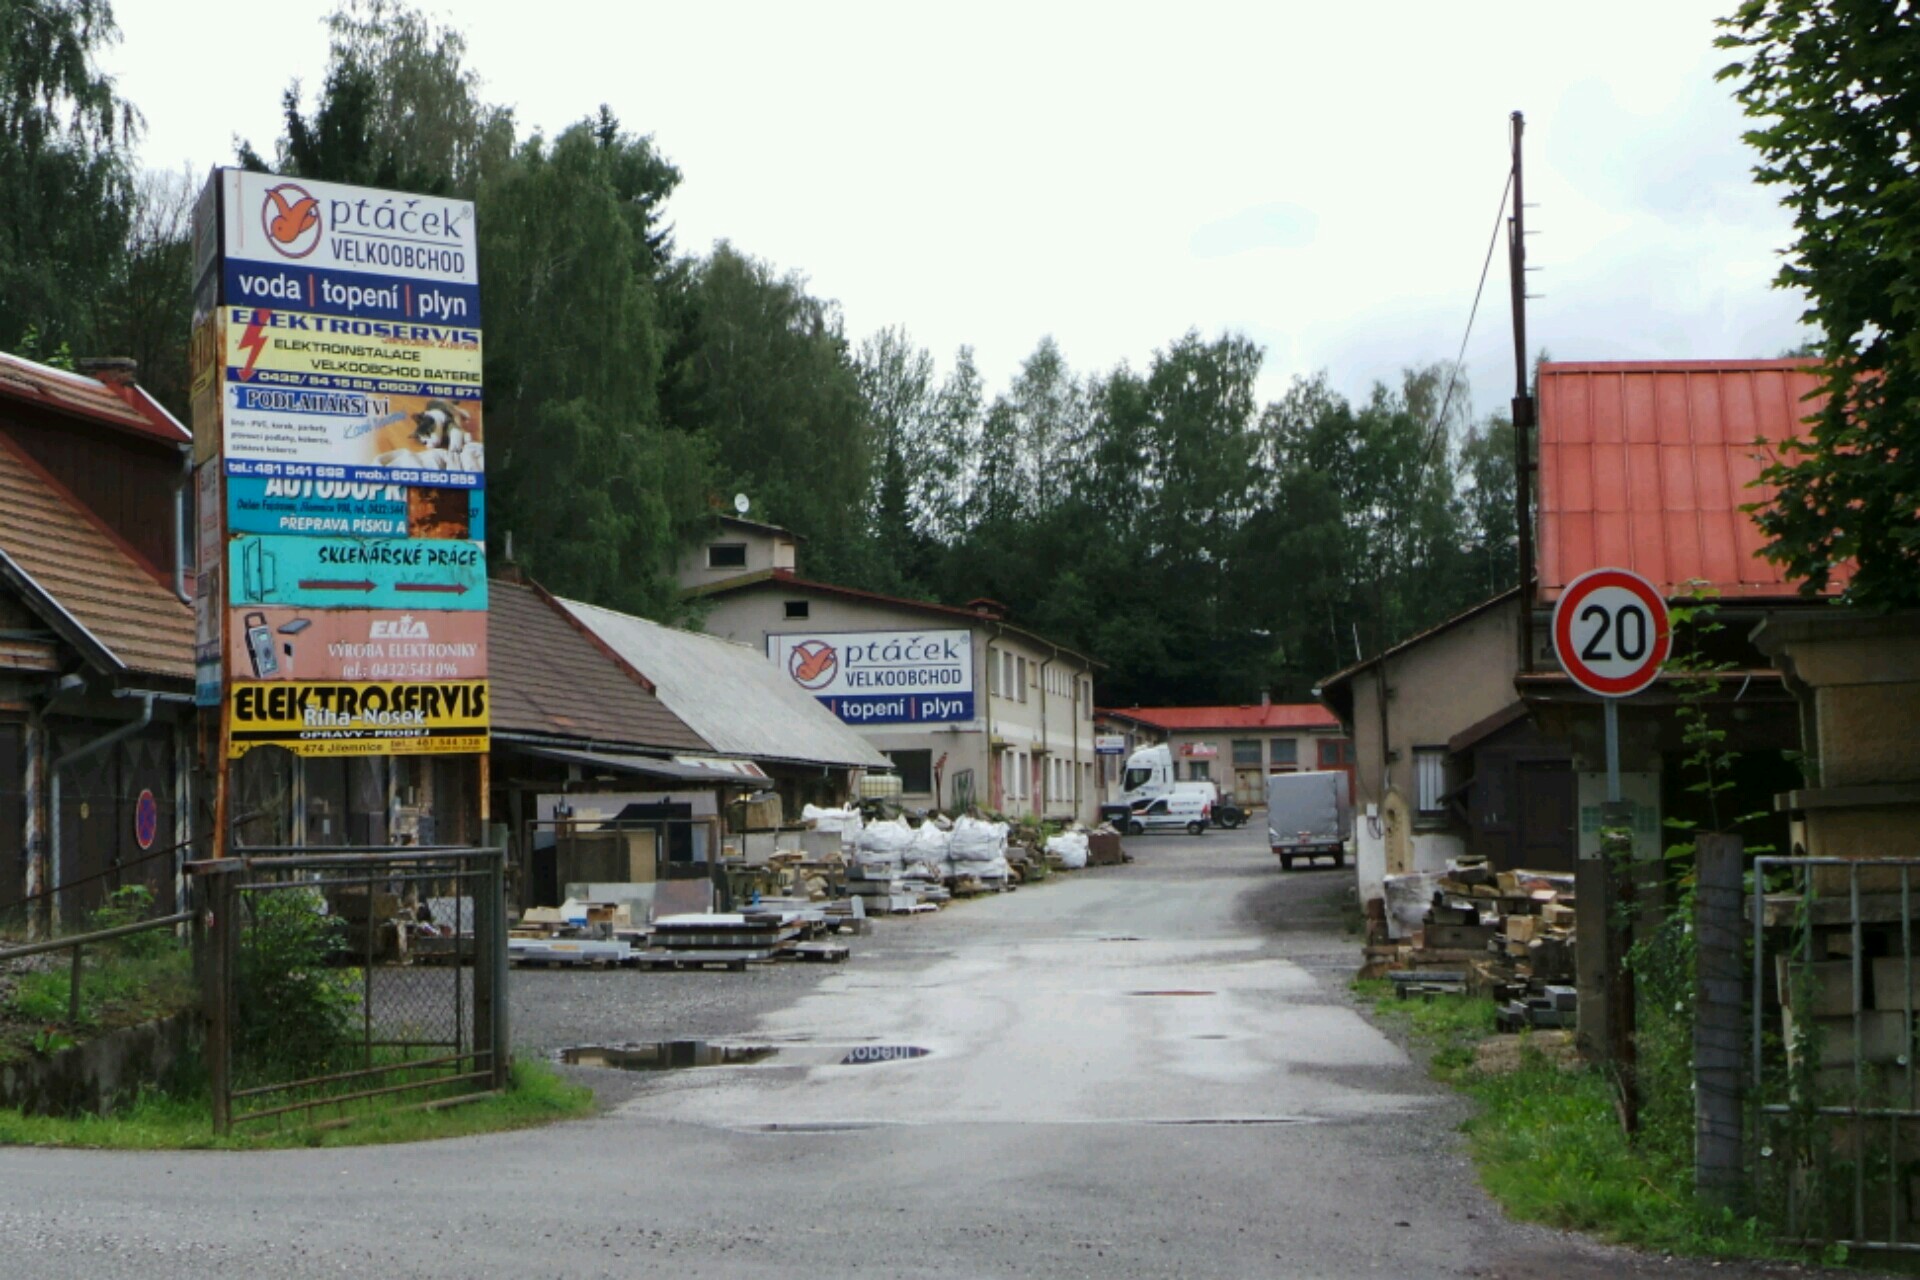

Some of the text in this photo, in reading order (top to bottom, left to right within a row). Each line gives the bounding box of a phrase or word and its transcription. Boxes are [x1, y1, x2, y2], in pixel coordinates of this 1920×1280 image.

[330, 198, 462, 238] ptáček
[330, 237, 465, 274] VELKOOBCHOD
[239, 273, 467, 320] voda topení plyn
[232, 309, 480, 345] ELEKTROSERVIS
[274, 339, 421, 362] ELEKTROINSTALACE
[310, 358, 481, 382] VELKOOBCHOD BATERIE
[264, 478, 408, 501] AUTODOPR
[280, 513, 350, 532] PŘEPRAVA
[353, 515, 393, 533] PÍSKU
[427, 545, 478, 566] PRÁCE
[1580, 604, 1647, 661] 20
[327, 640, 478, 658] VÝROBA ELEKTRONIKY
[844, 636, 960, 668] ptáček
[845, 669, 963, 688] VELKOOBCHOD
[234, 684, 486, 722] ELEKTROSERVIS
[841, 698, 964, 720] topení plyn
